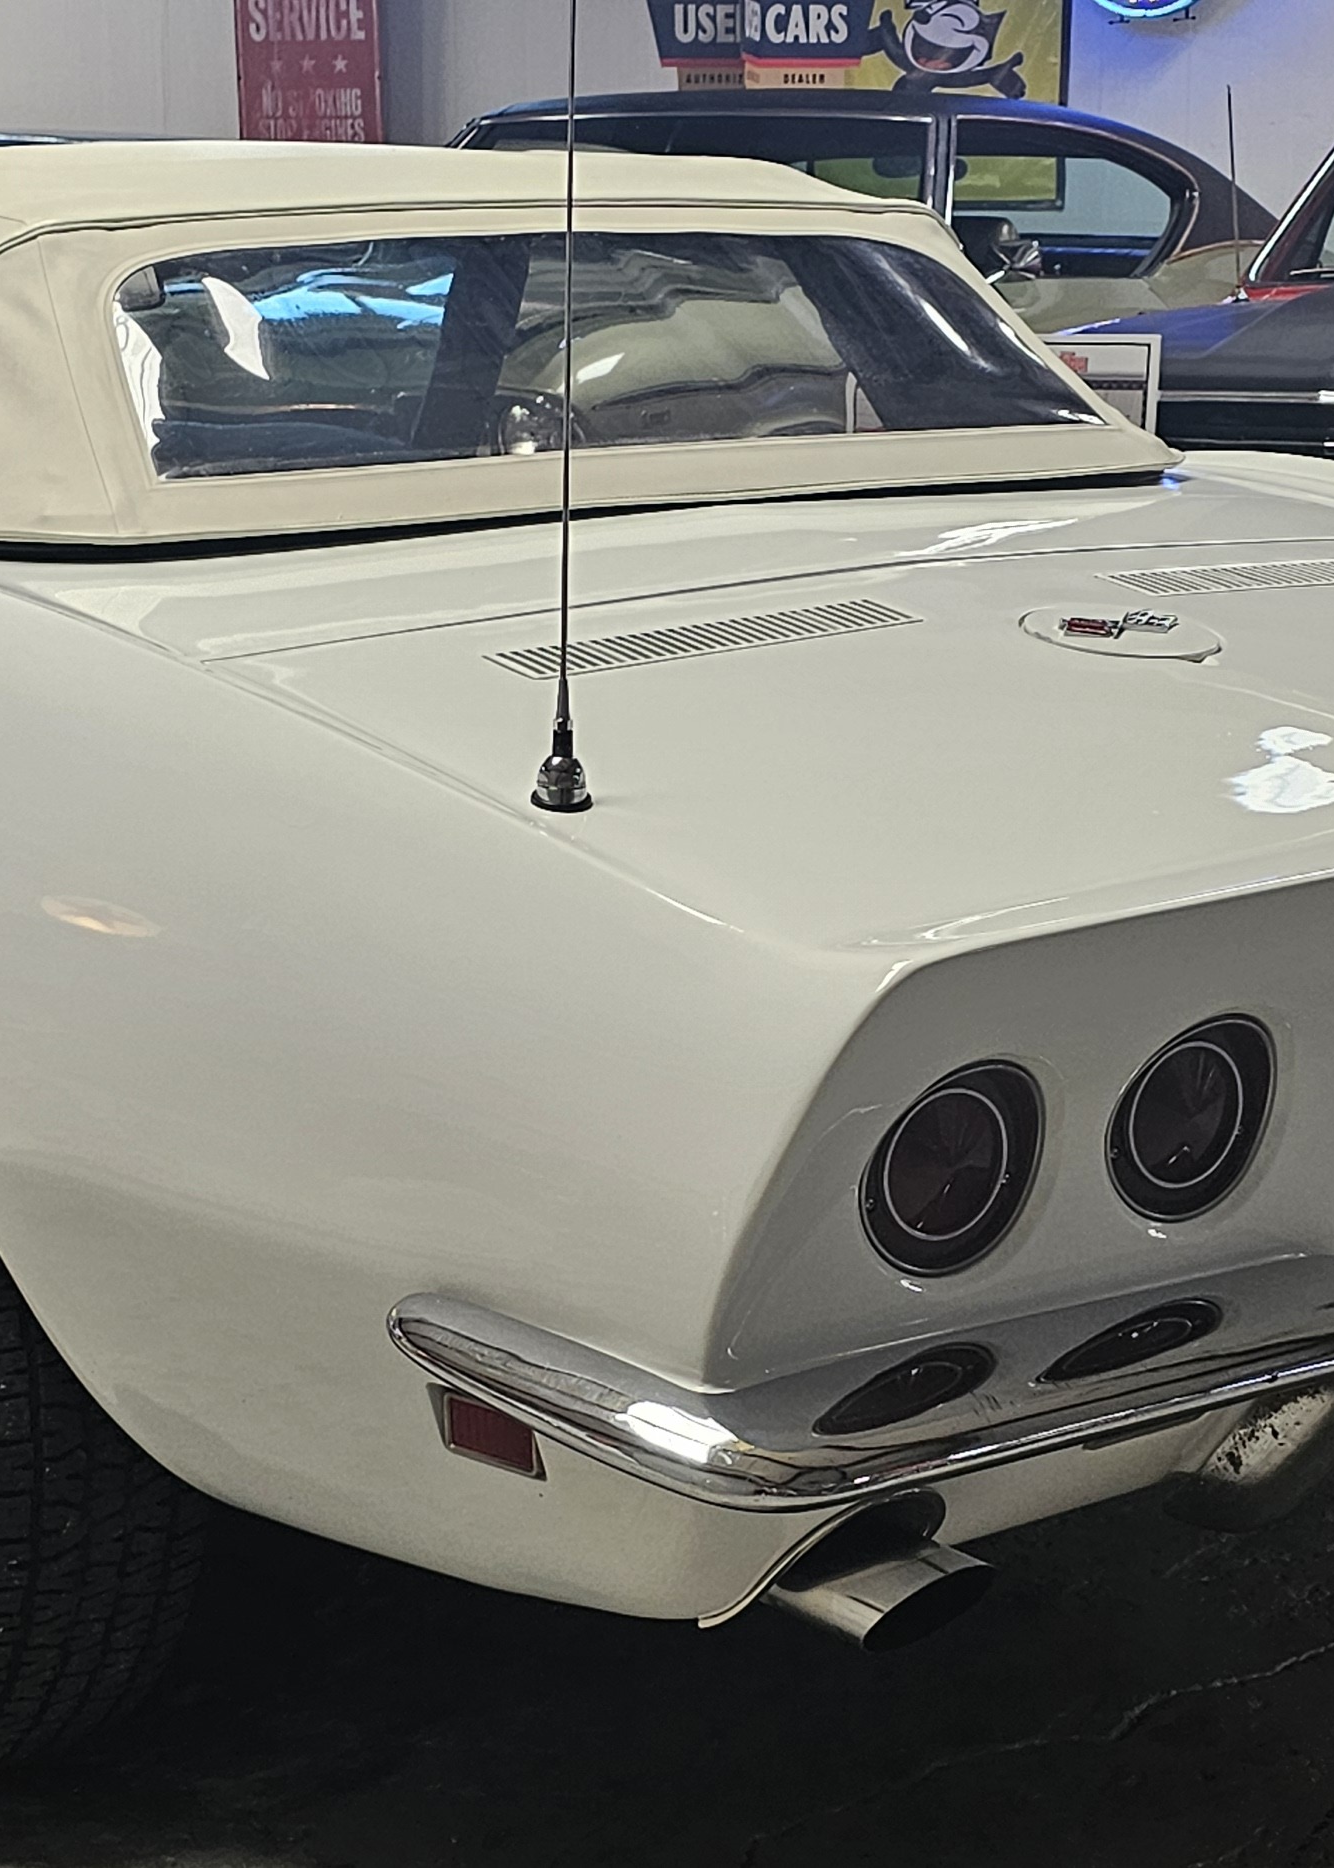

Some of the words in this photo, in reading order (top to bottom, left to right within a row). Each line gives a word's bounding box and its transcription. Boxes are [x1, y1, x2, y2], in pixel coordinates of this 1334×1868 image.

[248, 0, 366, 42] SERVICE
[766, 3, 848, 44] CARS
[686, 72, 760, 85] AUTHORIZ
[783, 73, 825, 85] DEALER
[262, 84, 282, 117] NO
